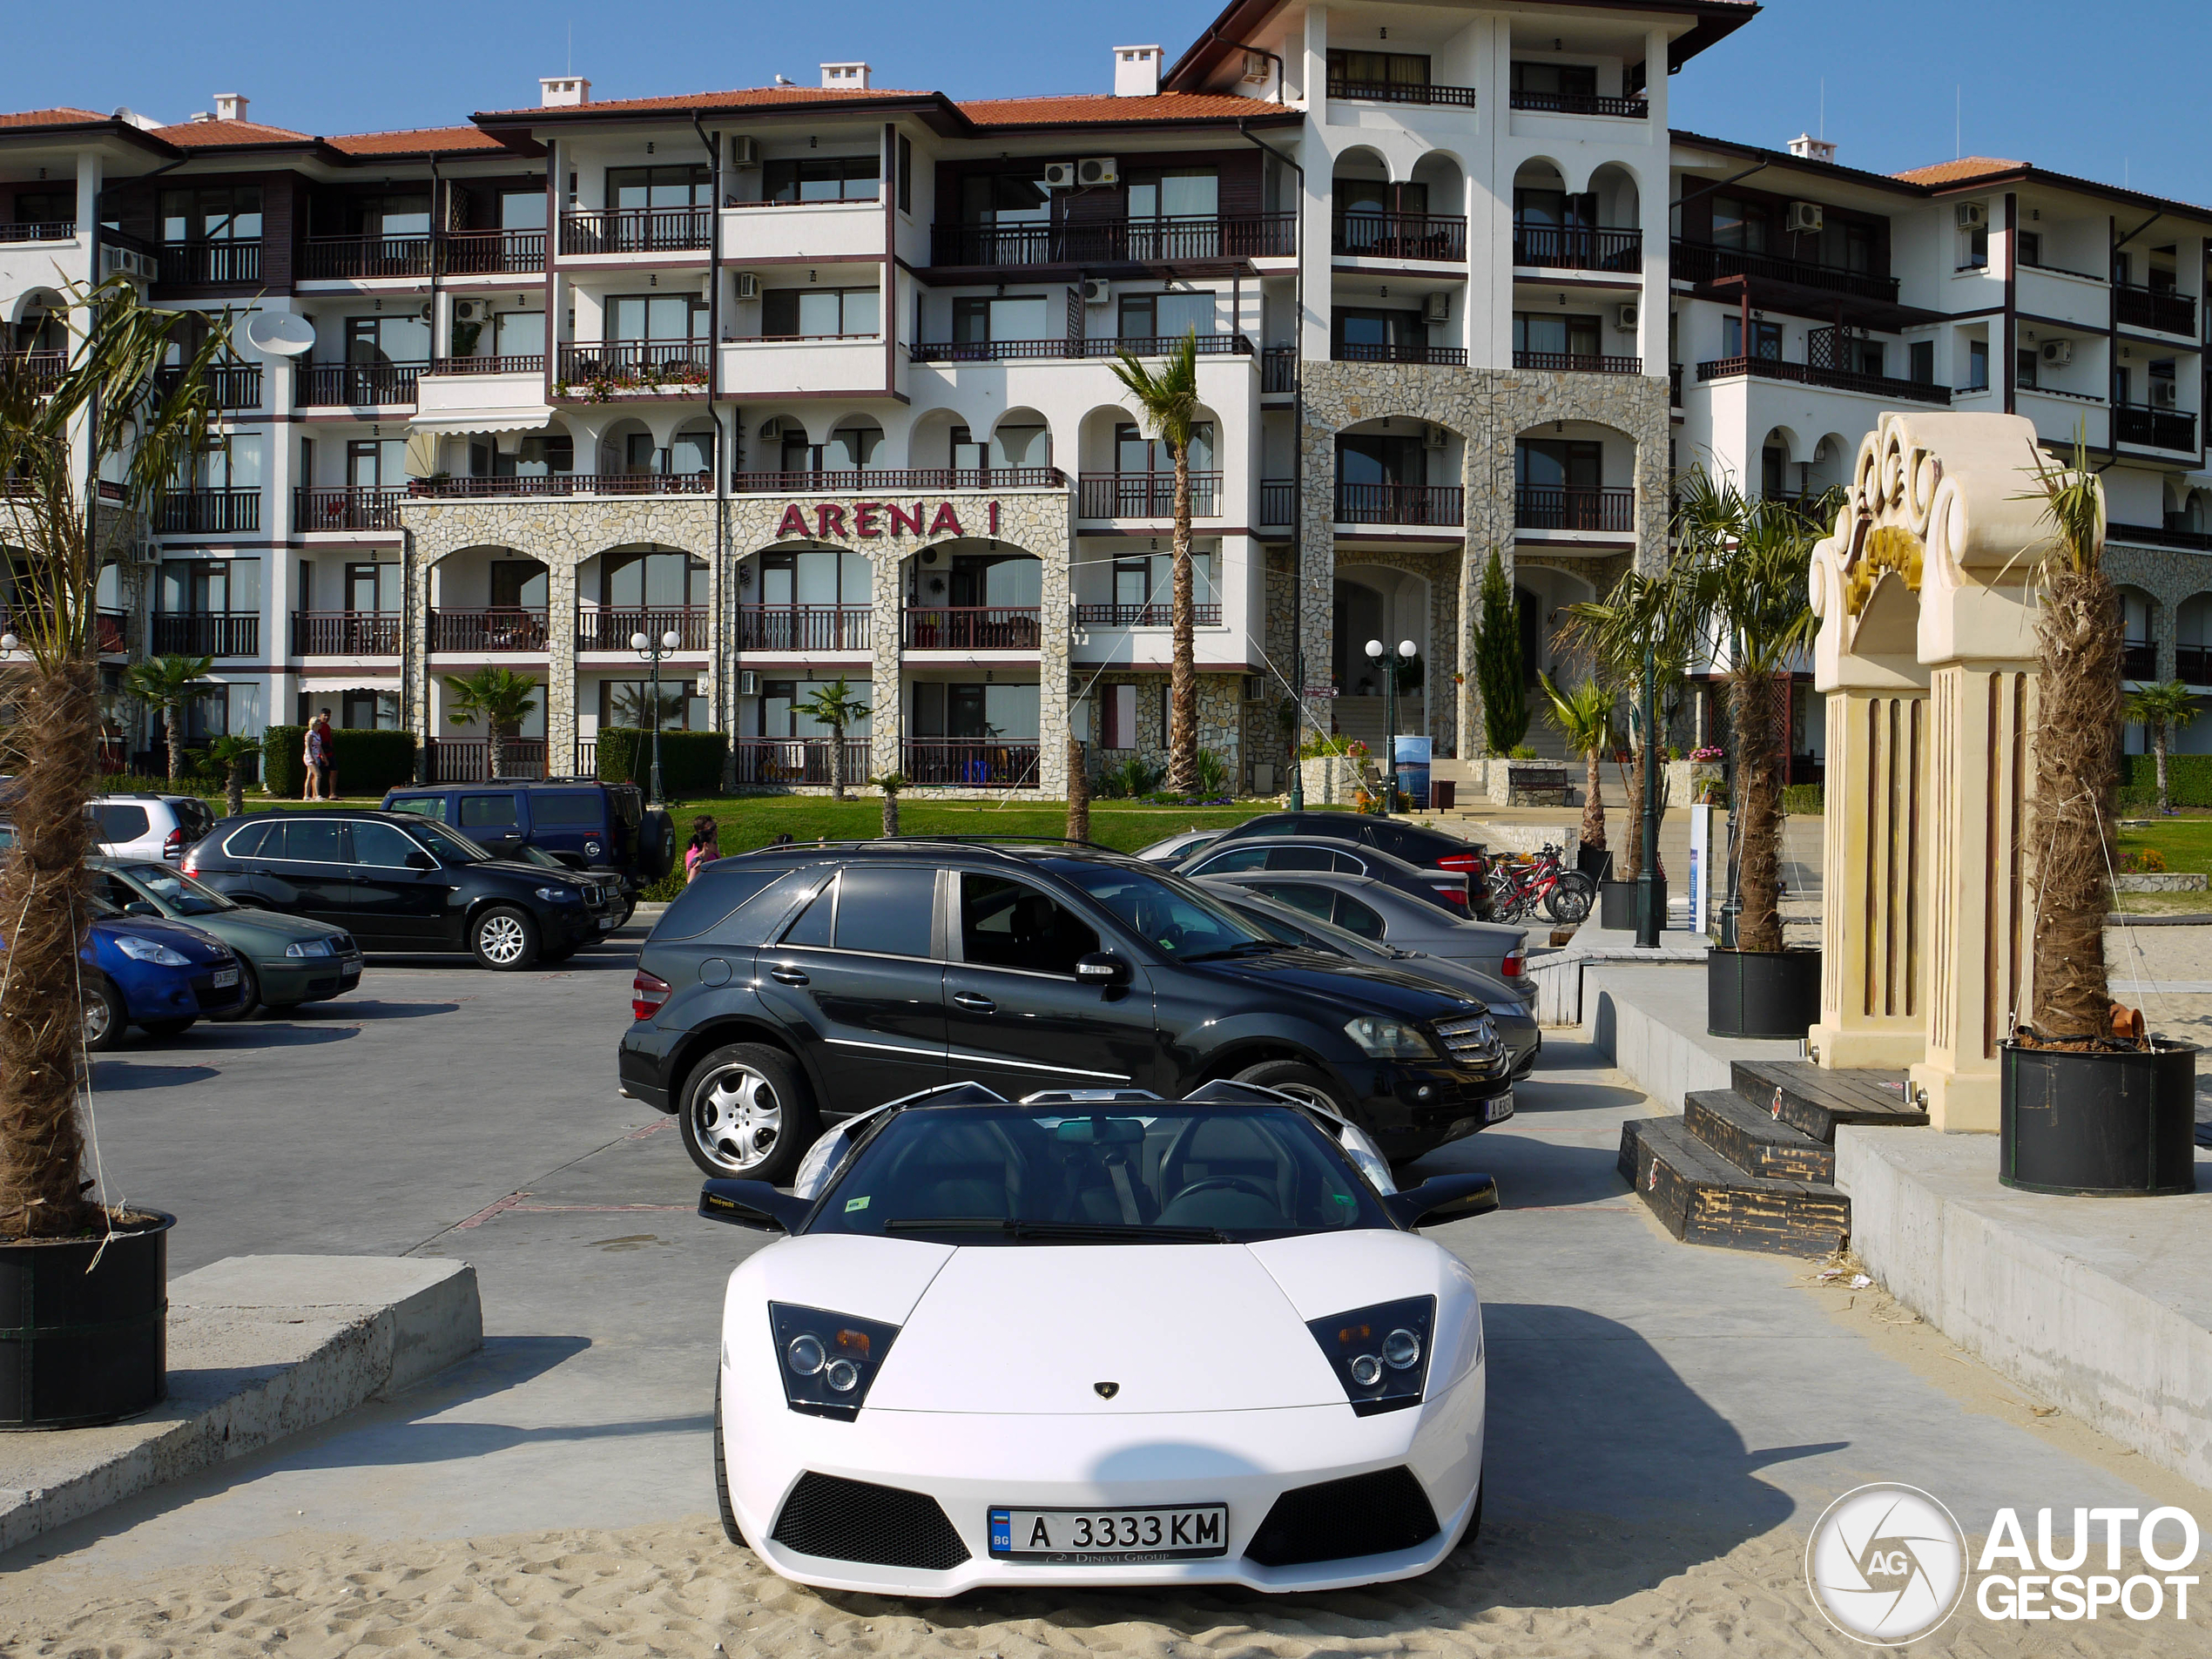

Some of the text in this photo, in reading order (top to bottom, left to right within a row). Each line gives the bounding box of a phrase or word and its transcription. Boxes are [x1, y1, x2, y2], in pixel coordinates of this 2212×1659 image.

[776, 501, 964, 537] ARENA
[1492, 1101, 1496, 1119] A
[994, 1535, 1009, 1545] BG
[1028, 1516, 1051, 1548] A
